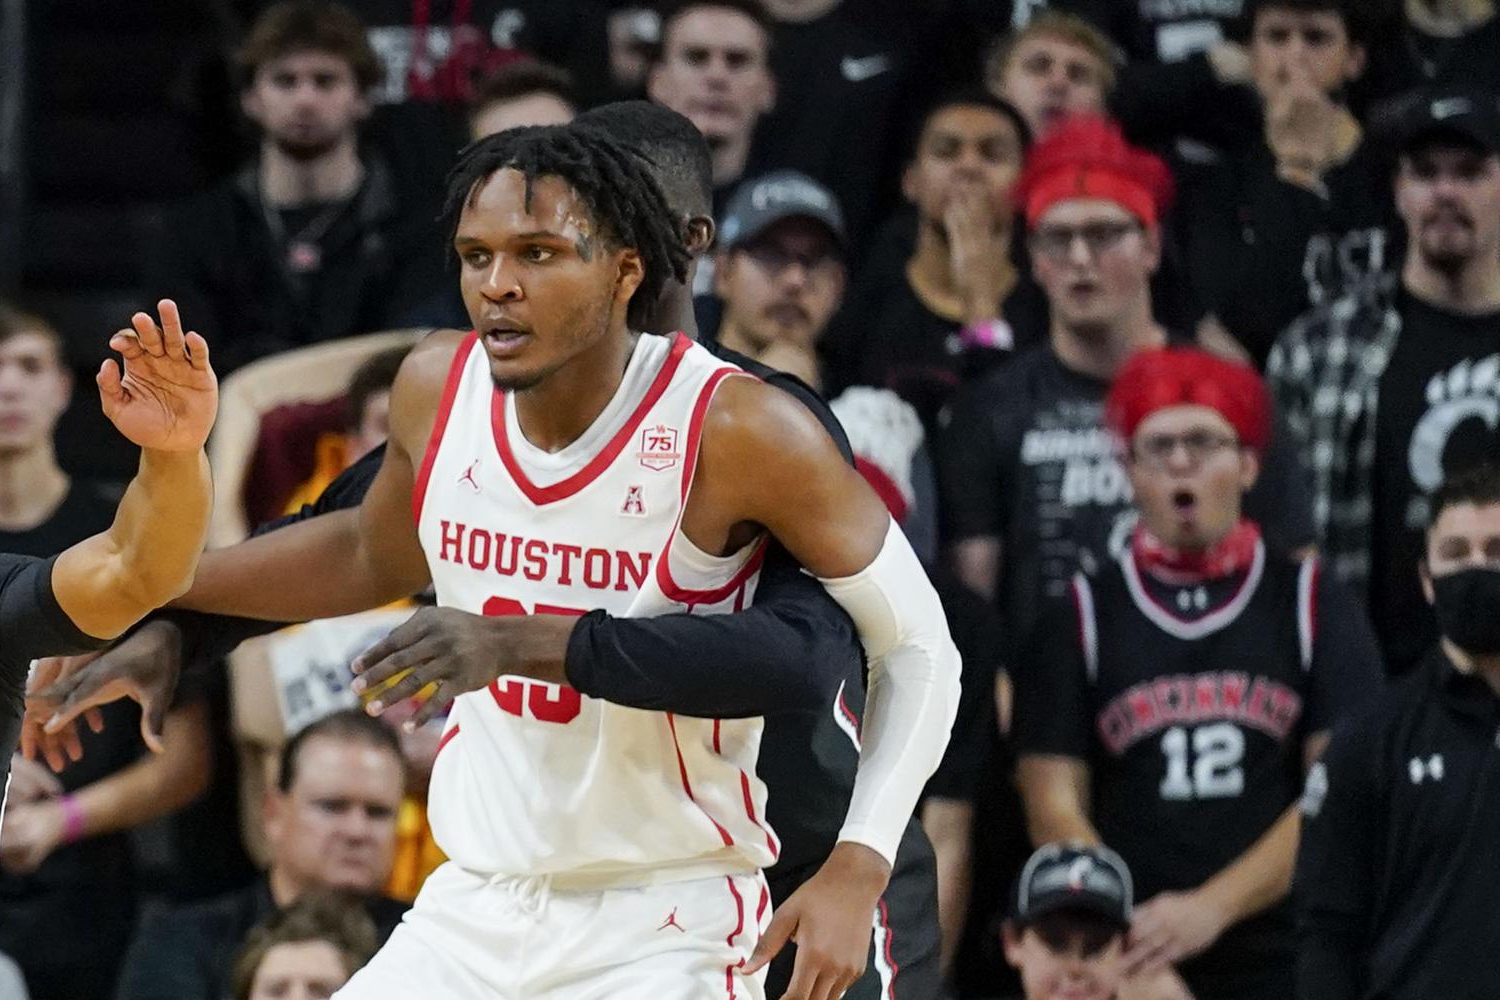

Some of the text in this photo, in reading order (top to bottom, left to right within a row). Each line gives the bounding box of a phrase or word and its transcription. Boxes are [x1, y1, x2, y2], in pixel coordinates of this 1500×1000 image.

[648, 437, 671, 451] 75
[439, 520, 652, 592] HOUSTON
[1097, 670, 1303, 755] CINCINNATI
[1159, 722, 1246, 799] 12
